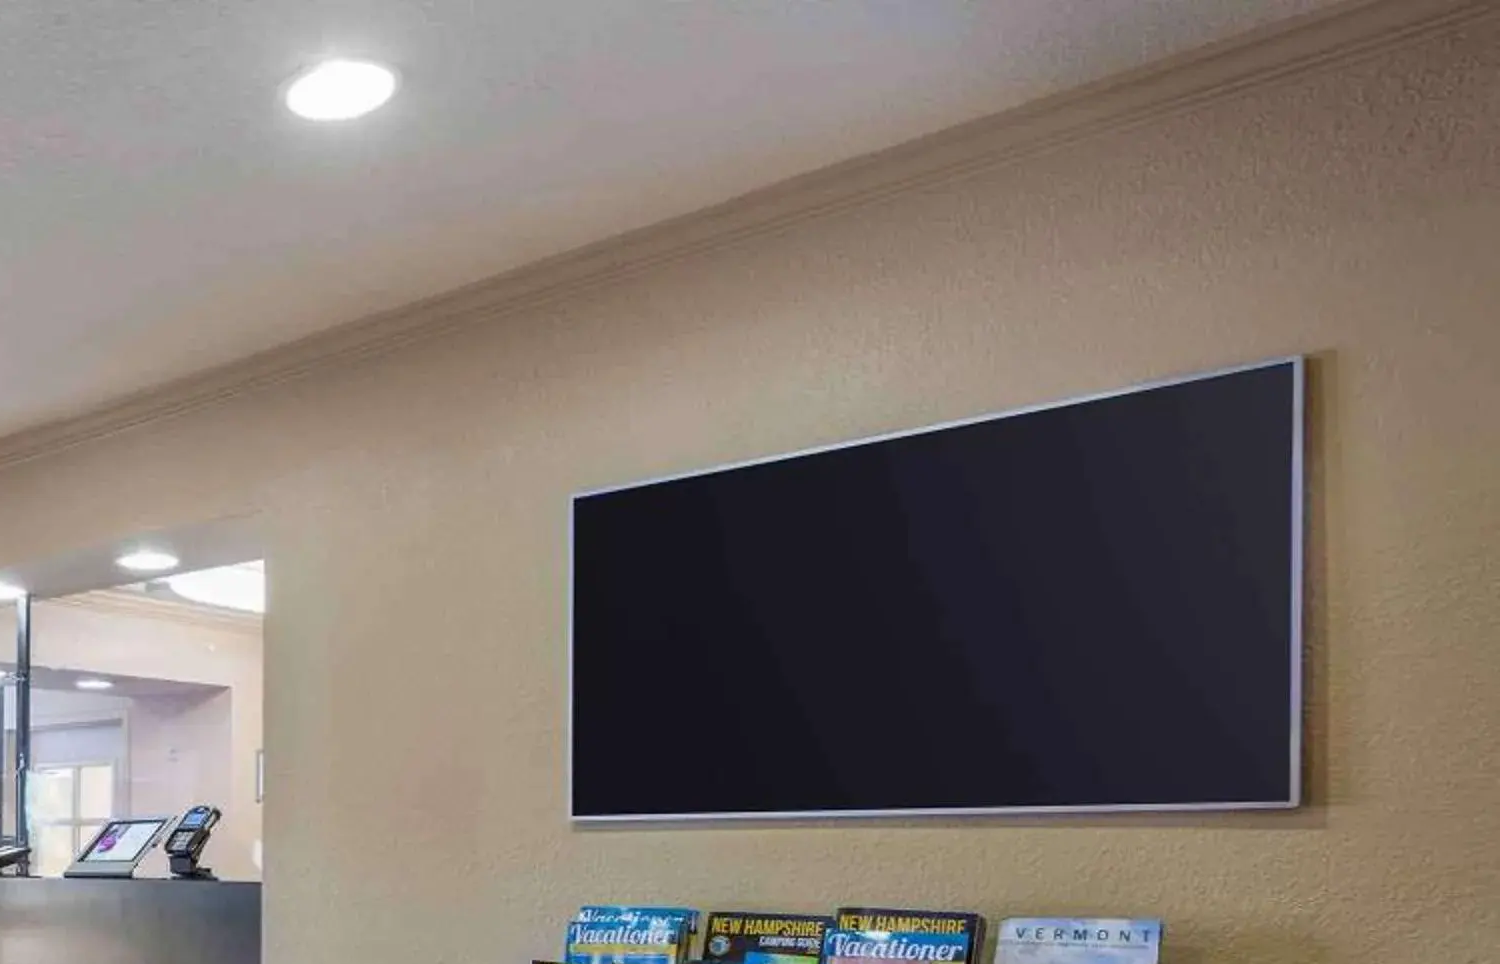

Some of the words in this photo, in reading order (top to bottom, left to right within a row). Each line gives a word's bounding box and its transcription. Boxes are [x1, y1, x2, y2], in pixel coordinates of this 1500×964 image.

[571, 922, 674, 945] Vacationer
[711, 916, 743, 934] NEW
[744, 918, 825, 937] HAMPSHIRE
[840, 913, 871, 931] NEW
[875, 915, 968, 934] HAMPSHIRE
[1015, 926, 1151, 942] VERMONT
[828, 932, 963, 961] Vacationer
